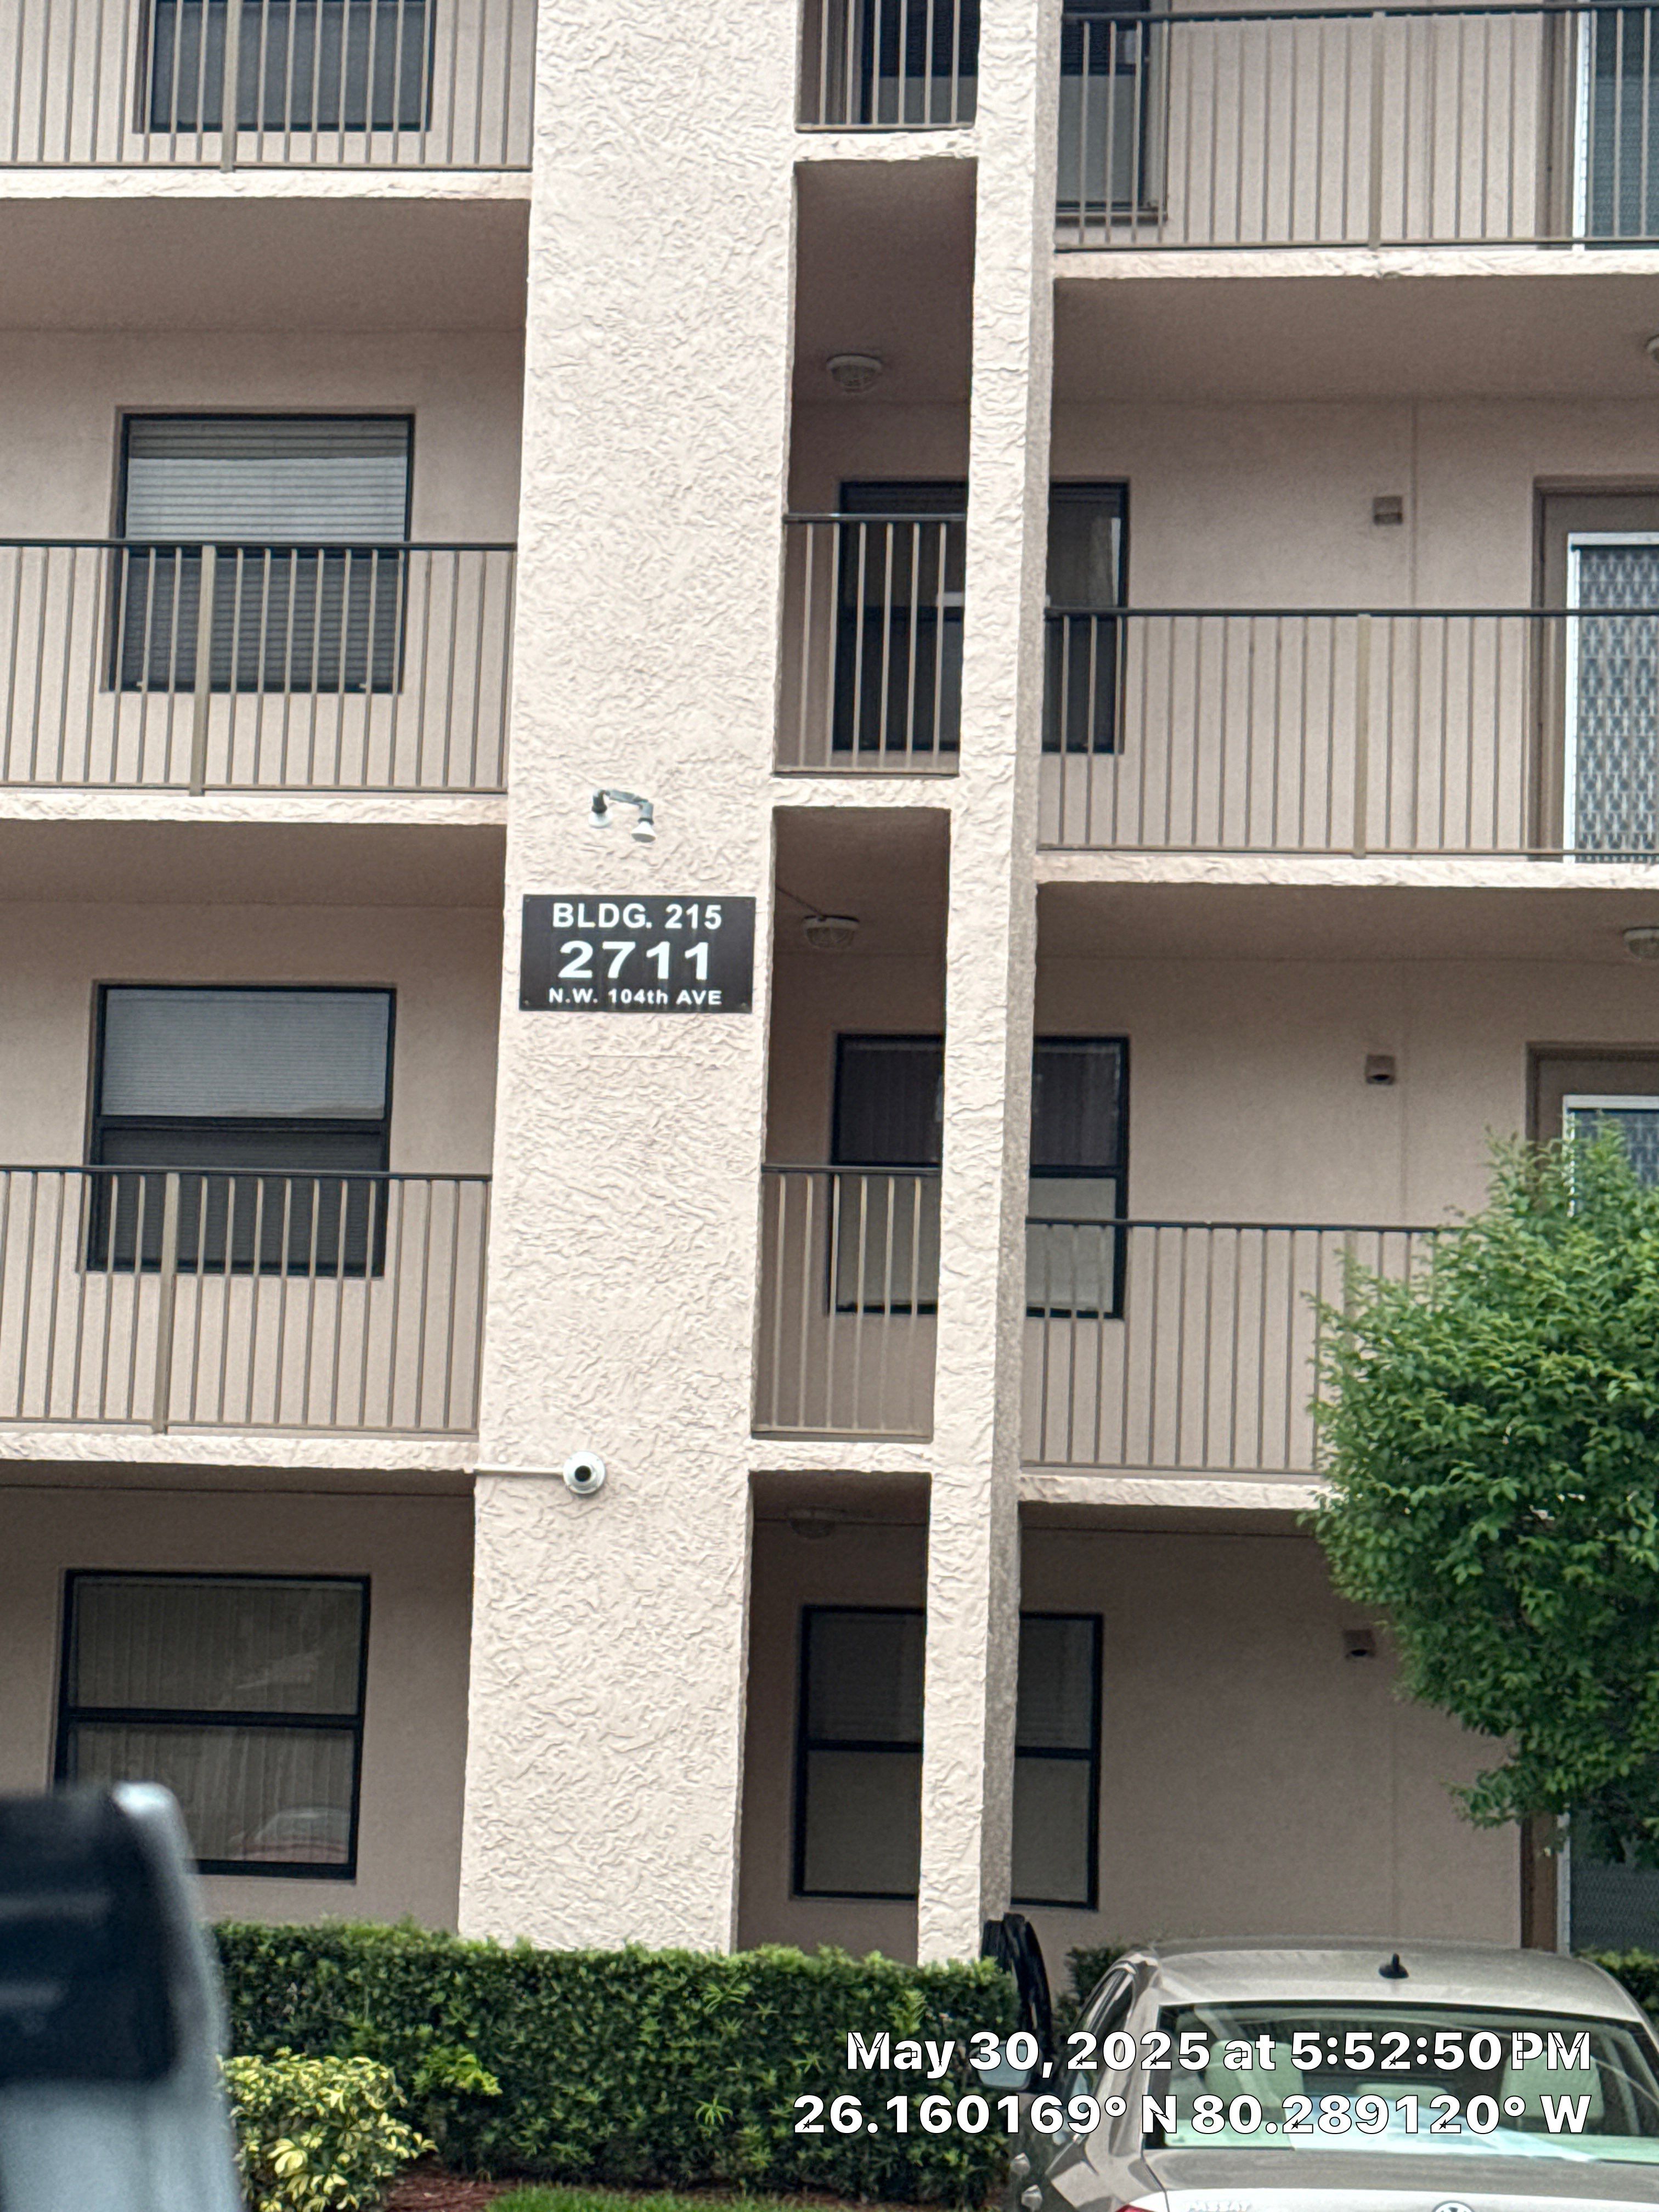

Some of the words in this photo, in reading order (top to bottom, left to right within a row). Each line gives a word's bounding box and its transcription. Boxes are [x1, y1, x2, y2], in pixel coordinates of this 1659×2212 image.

[552, 902, 653, 929] BLDG.
[664, 903, 723, 930] 215
[557, 940, 709, 981] 2711
[548, 987, 599, 1004] N.W.
[607, 988, 669, 1006] 104th
[675, 989, 723, 1006] AVE
